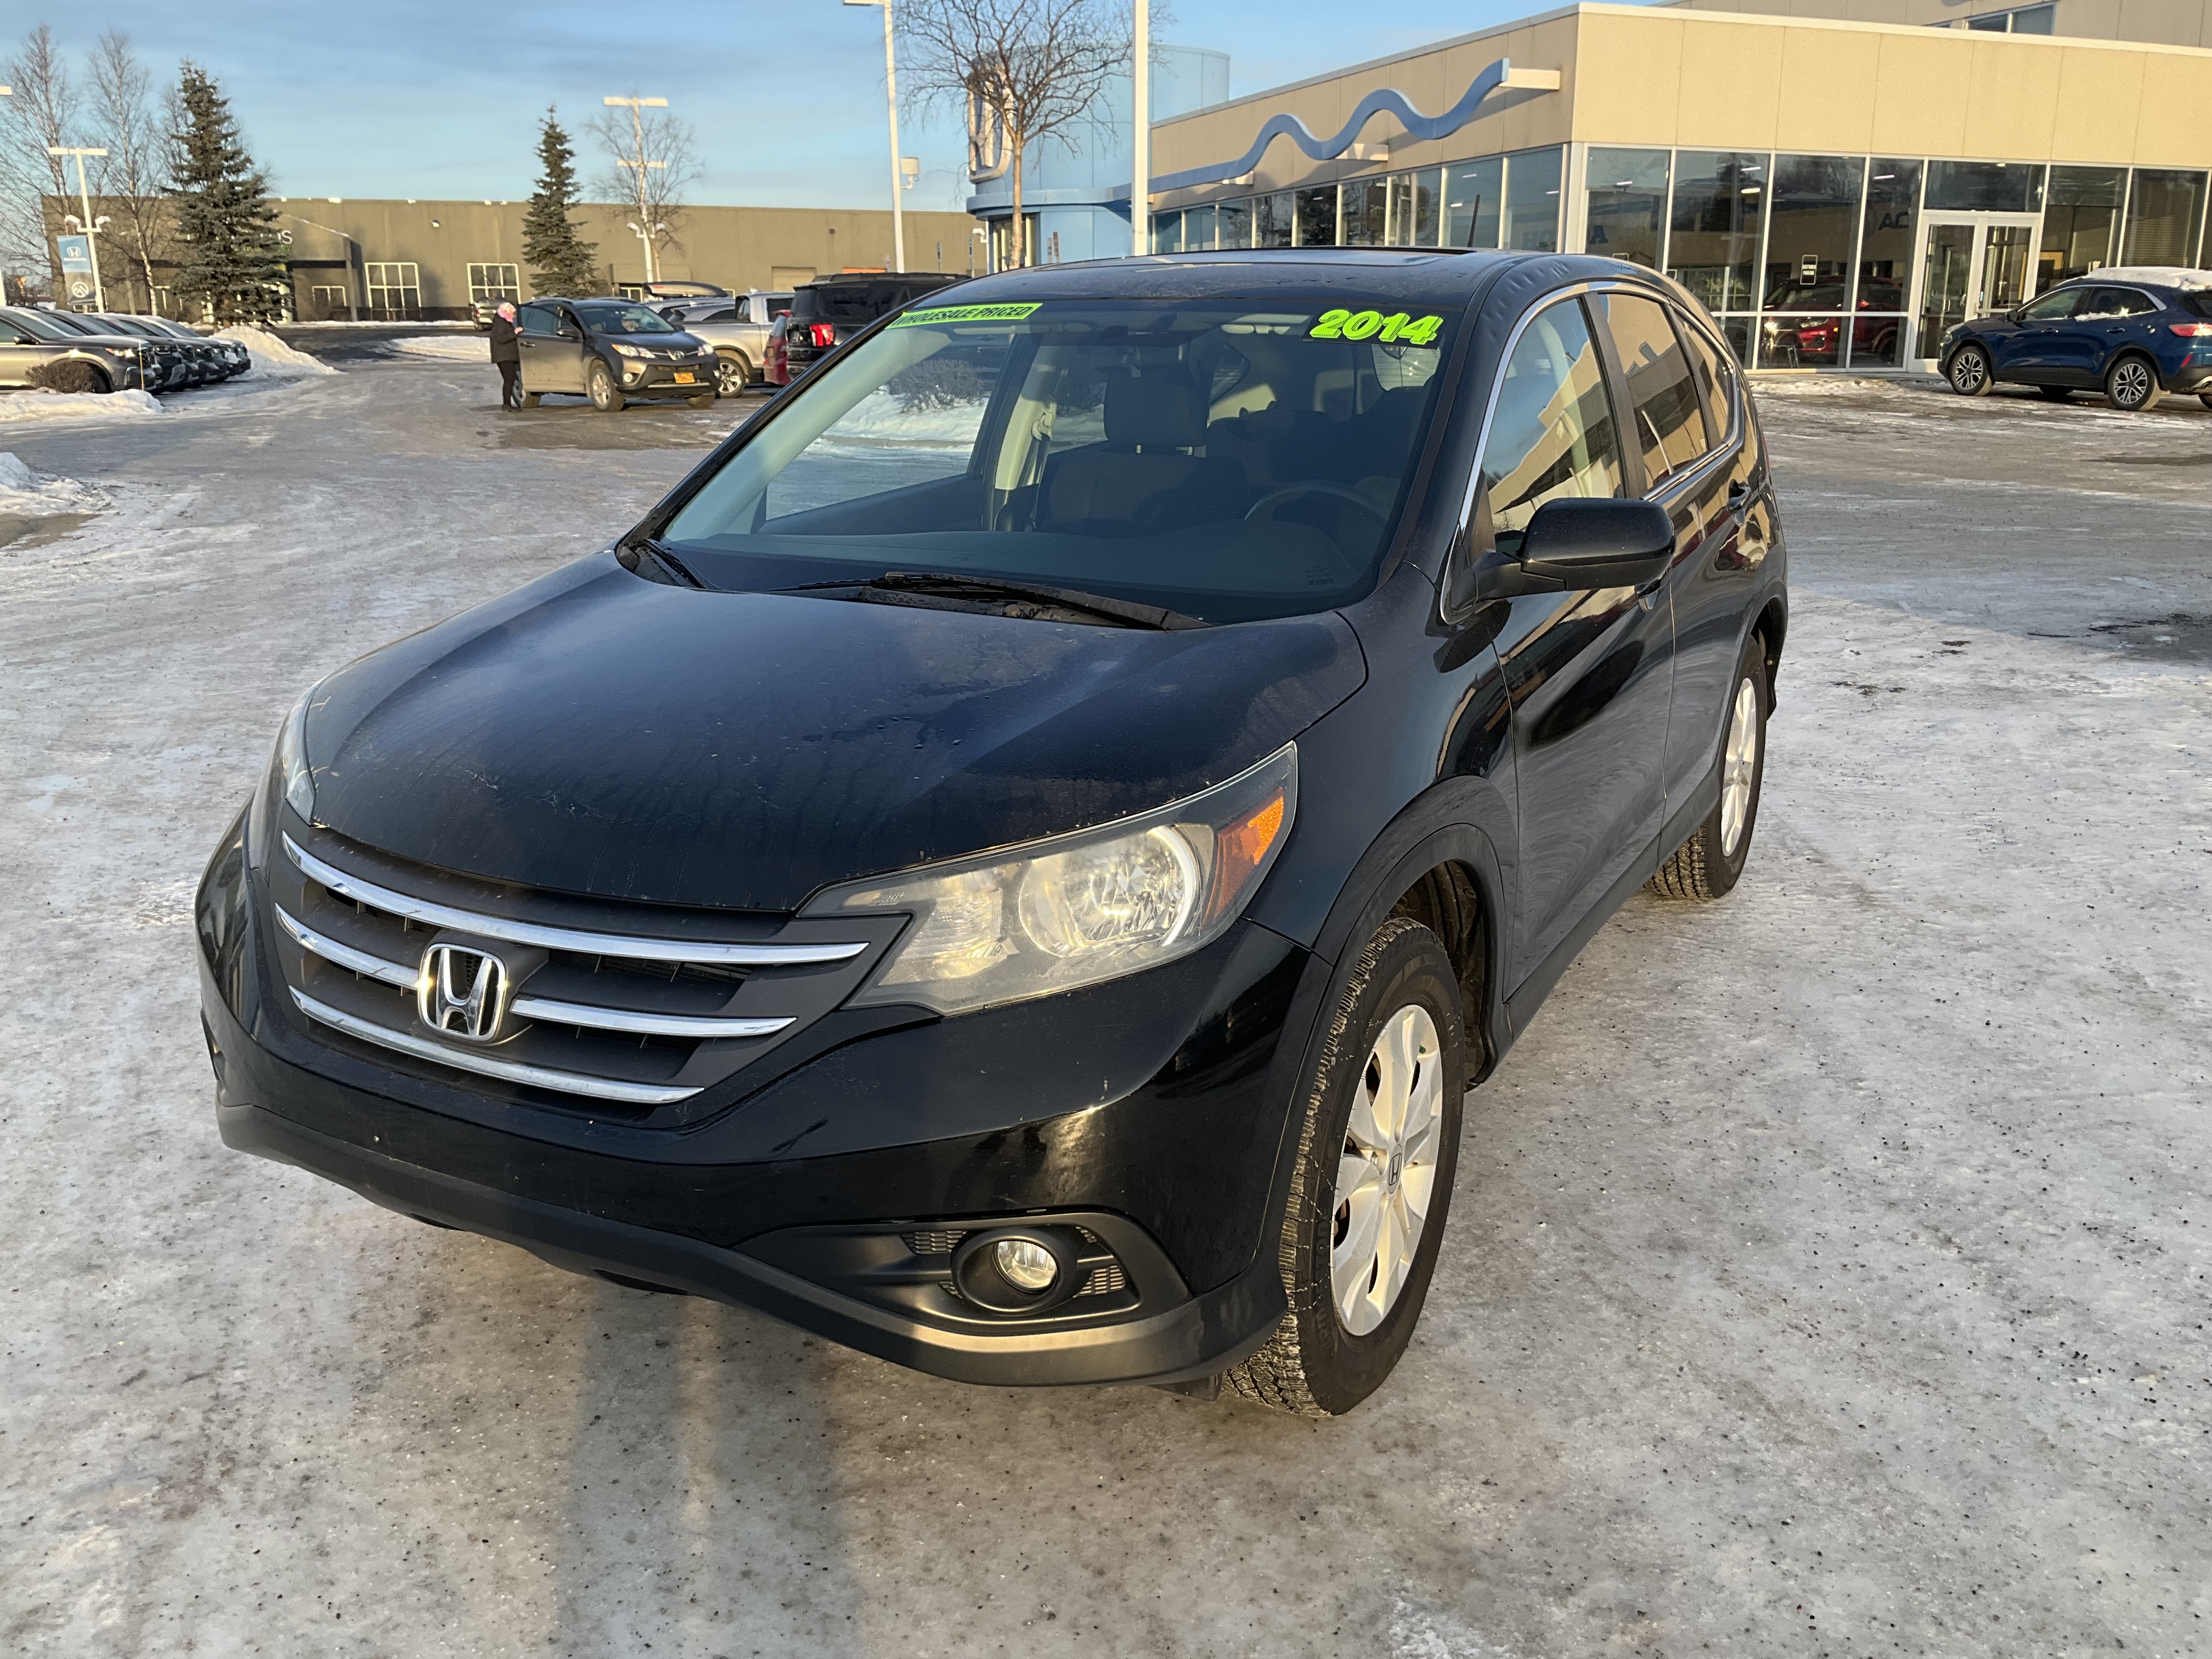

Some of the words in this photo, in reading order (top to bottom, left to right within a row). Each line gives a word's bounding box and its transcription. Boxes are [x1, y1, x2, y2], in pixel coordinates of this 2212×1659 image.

[890, 308, 979, 326] WHOLESALE
[971, 307, 1034, 318] PRICED
[1309, 309, 1444, 345] 2014
